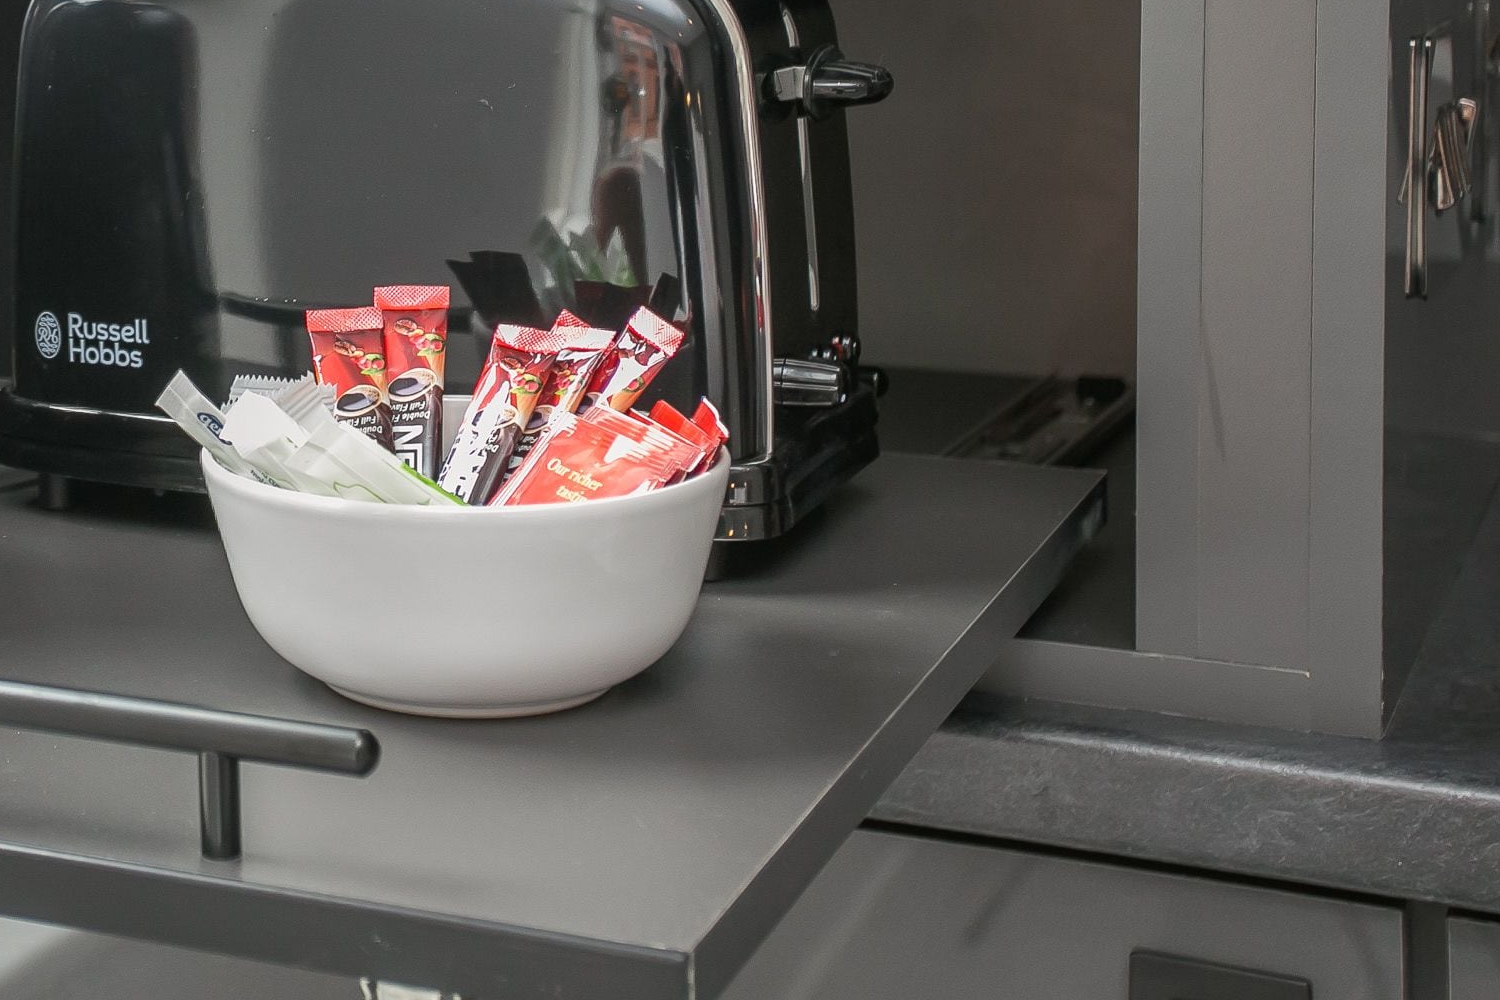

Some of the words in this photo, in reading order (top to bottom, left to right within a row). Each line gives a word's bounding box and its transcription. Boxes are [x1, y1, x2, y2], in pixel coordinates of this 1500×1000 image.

[67, 313, 150, 344] Russell
[68, 338, 144, 368] Hobbs
[409, 401, 426, 410] Full
[547, 457, 570, 476] Our
[568, 469, 603, 491] richer
